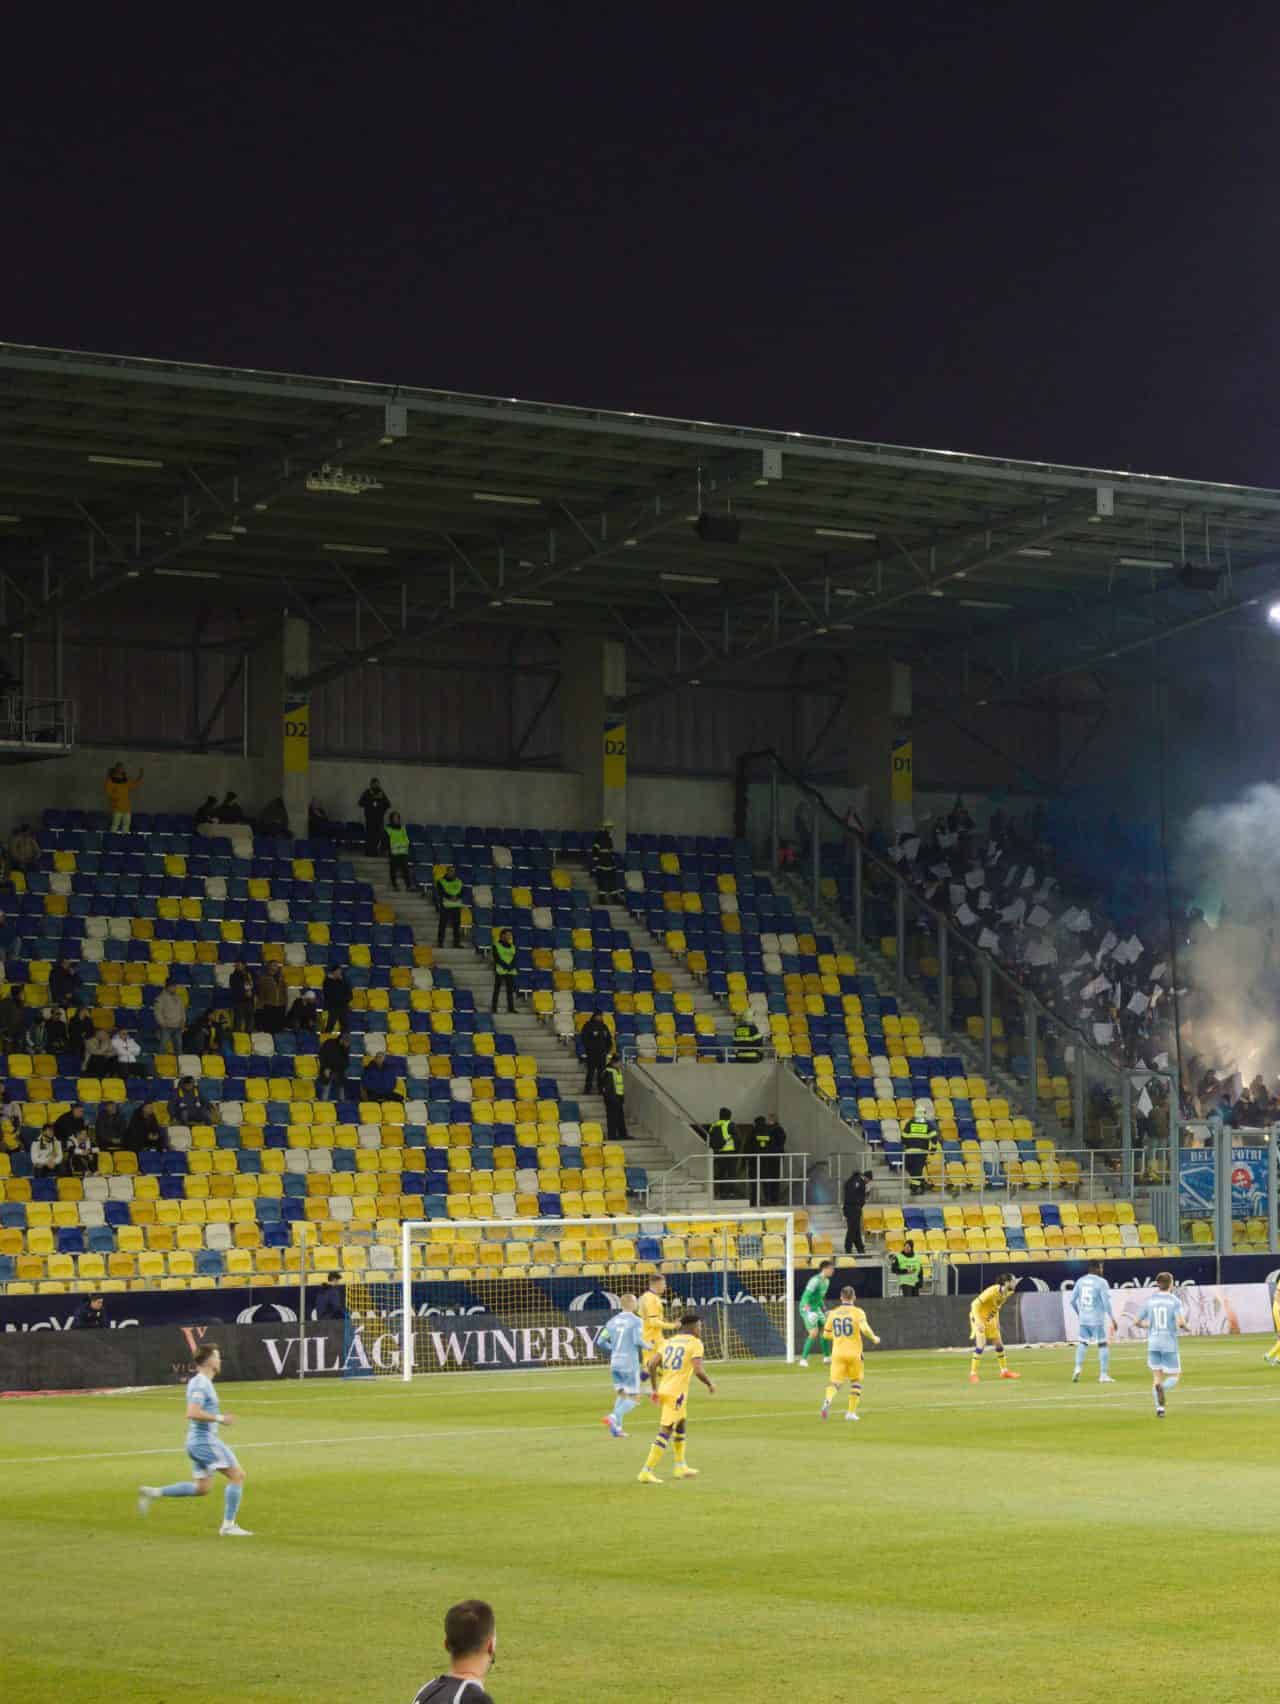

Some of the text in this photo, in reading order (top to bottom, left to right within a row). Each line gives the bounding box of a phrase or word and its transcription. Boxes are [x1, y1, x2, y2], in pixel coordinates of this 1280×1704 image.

[285, 722, 308, 737] D2
[605, 741, 625, 755] D2
[895, 759, 911, 771] D1
[832, 1317, 853, 1337] 66
[1153, 1306, 1168, 1330] 10
[431, 1325, 604, 1367] WINERY
[616, 1327, 625, 1350] 7
[664, 1346, 685, 1370] 28
